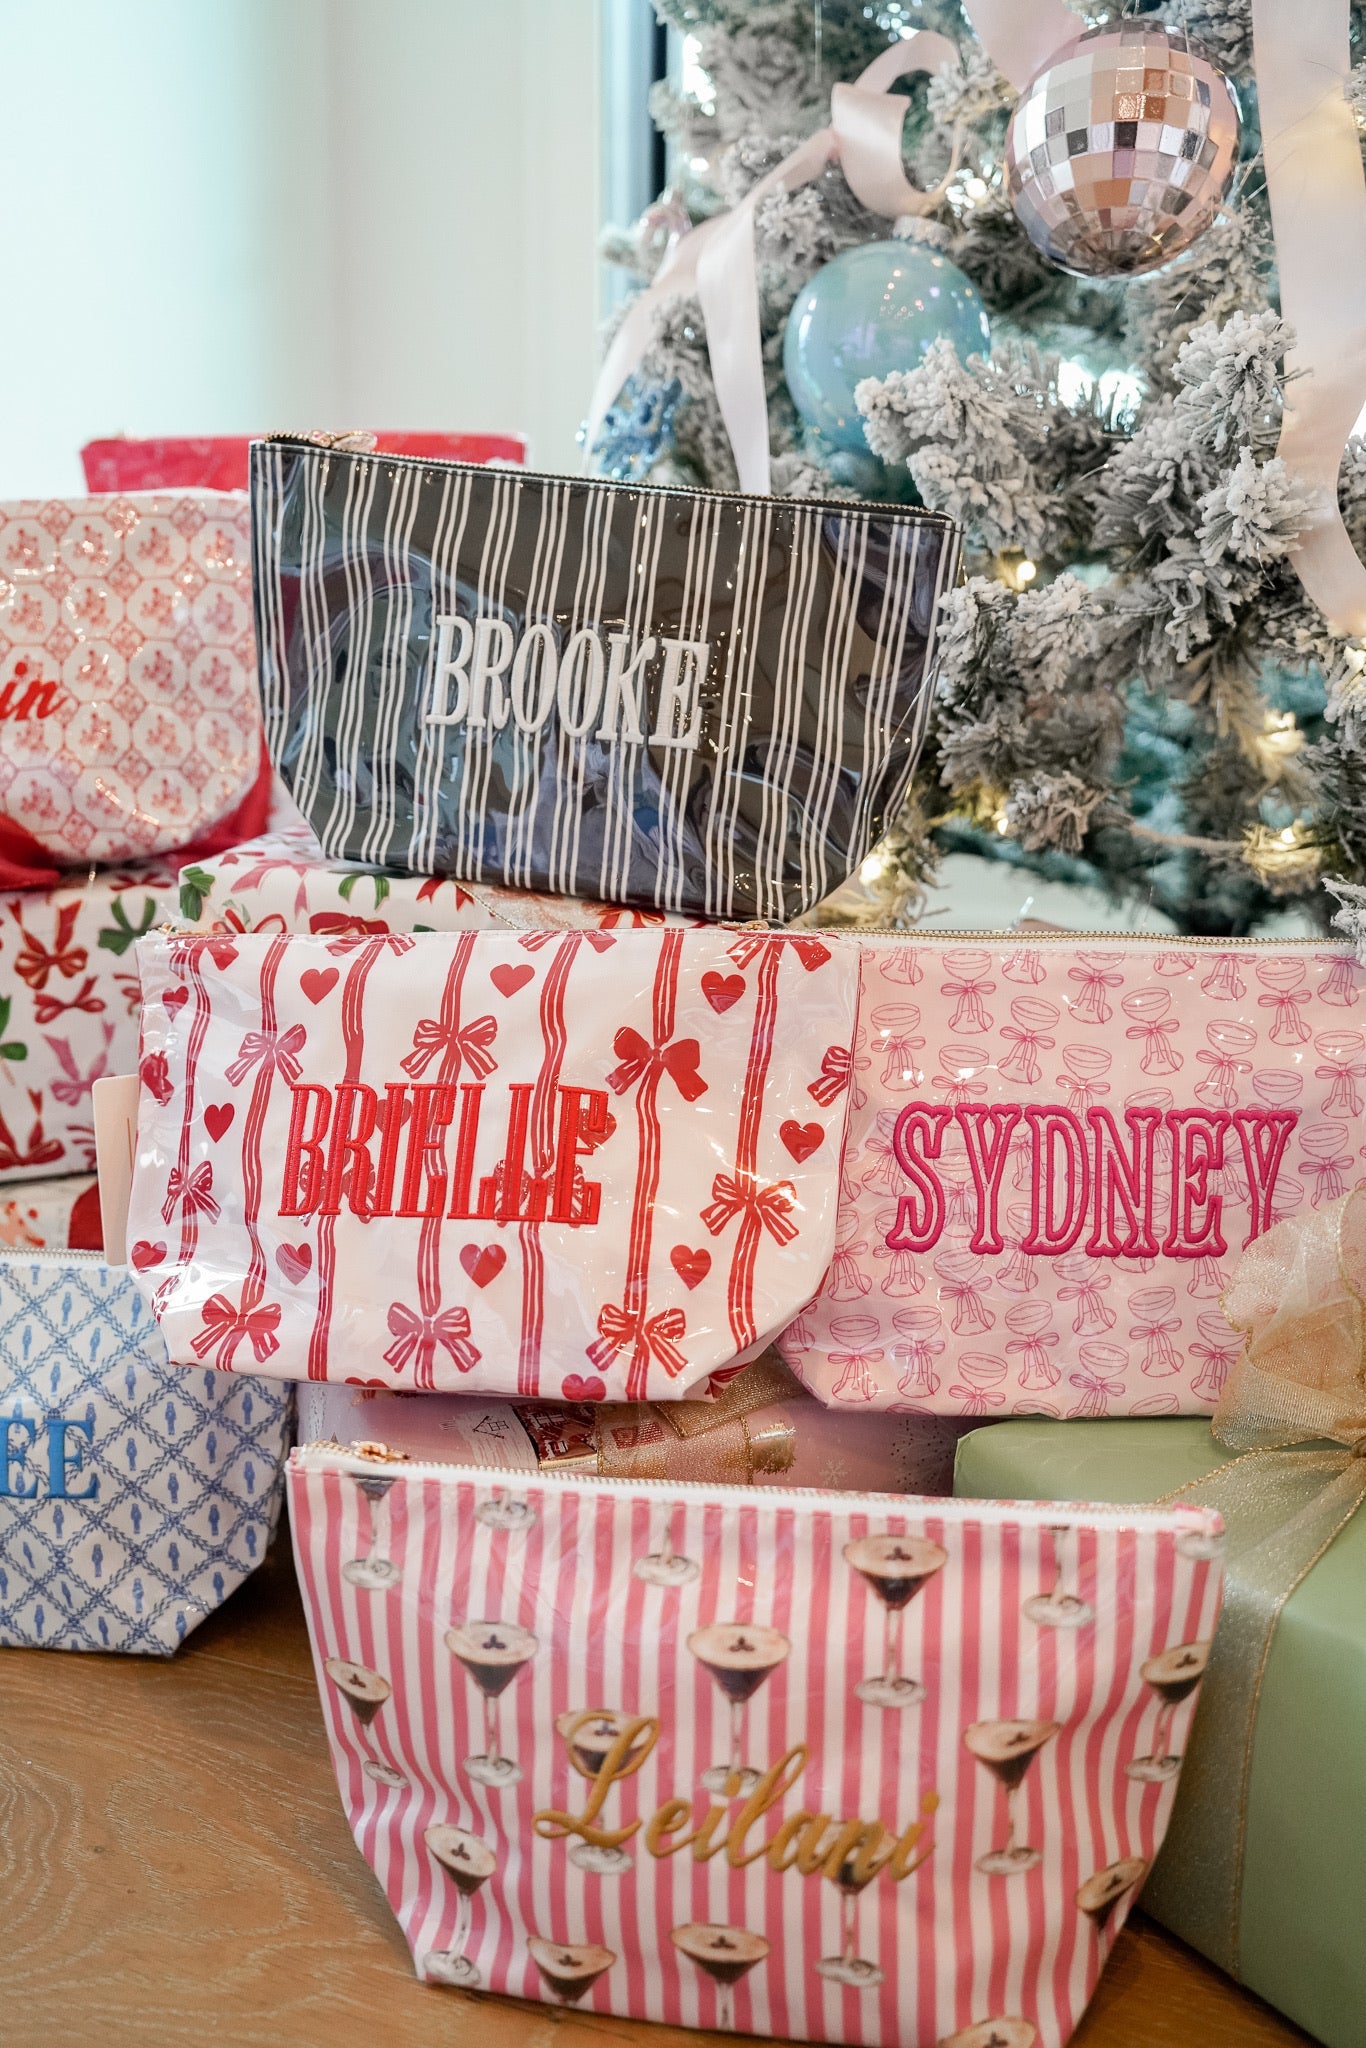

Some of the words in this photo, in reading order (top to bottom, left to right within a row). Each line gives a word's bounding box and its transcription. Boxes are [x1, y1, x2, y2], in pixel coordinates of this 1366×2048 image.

[425, 614, 710, 750] BROOKE
[277, 1082, 608, 1225] BRIELLE
[885, 1102, 1298, 1258] SYDNEY
[532, 1708, 940, 1882] Leilani
